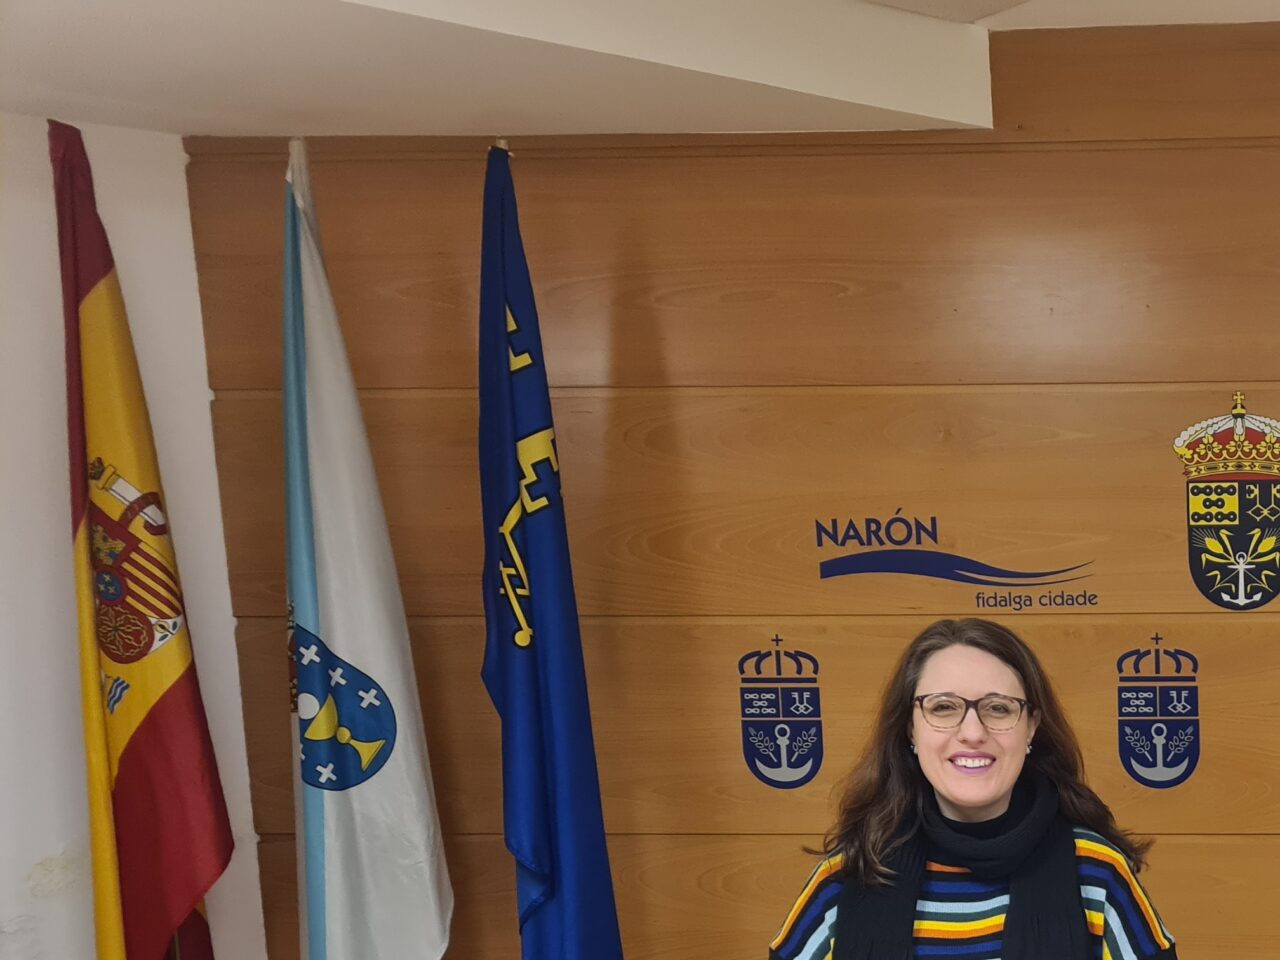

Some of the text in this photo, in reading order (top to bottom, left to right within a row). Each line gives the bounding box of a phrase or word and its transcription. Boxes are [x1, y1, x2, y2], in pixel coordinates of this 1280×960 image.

[815, 508, 938, 547] NARÓN
[975, 590, 1098, 611] fidalga cidade
